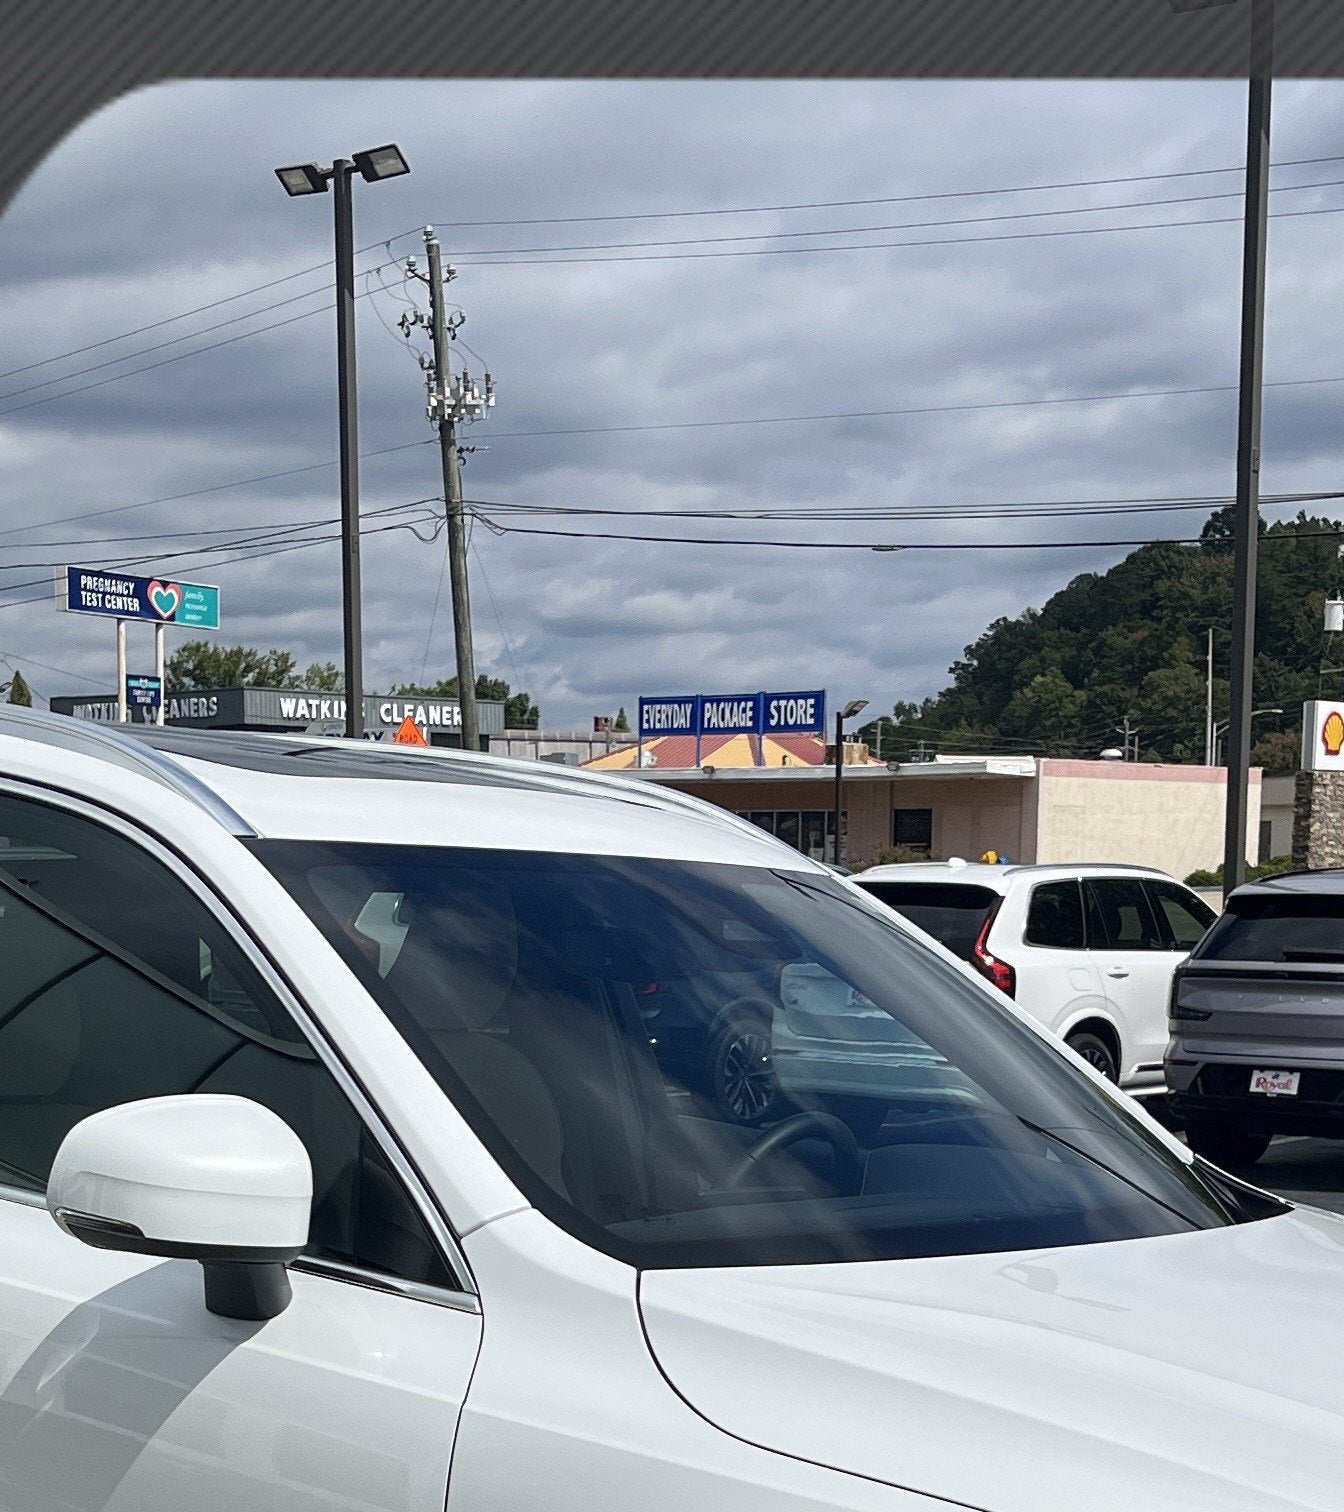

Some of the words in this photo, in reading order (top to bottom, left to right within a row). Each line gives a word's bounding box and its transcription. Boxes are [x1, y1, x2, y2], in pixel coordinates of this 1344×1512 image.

[80, 574, 135, 595] PREGNANCY
[80, 591, 103, 608] TEST
[105, 594, 140, 612] CENTER
[379, 703, 463, 726] CLEANER
[642, 703, 693, 730] EVERYDAY
[703, 701, 754, 729] PACKAGE
[769, 698, 815, 727] STORE
[1255, 1077, 1293, 1092] Royal
